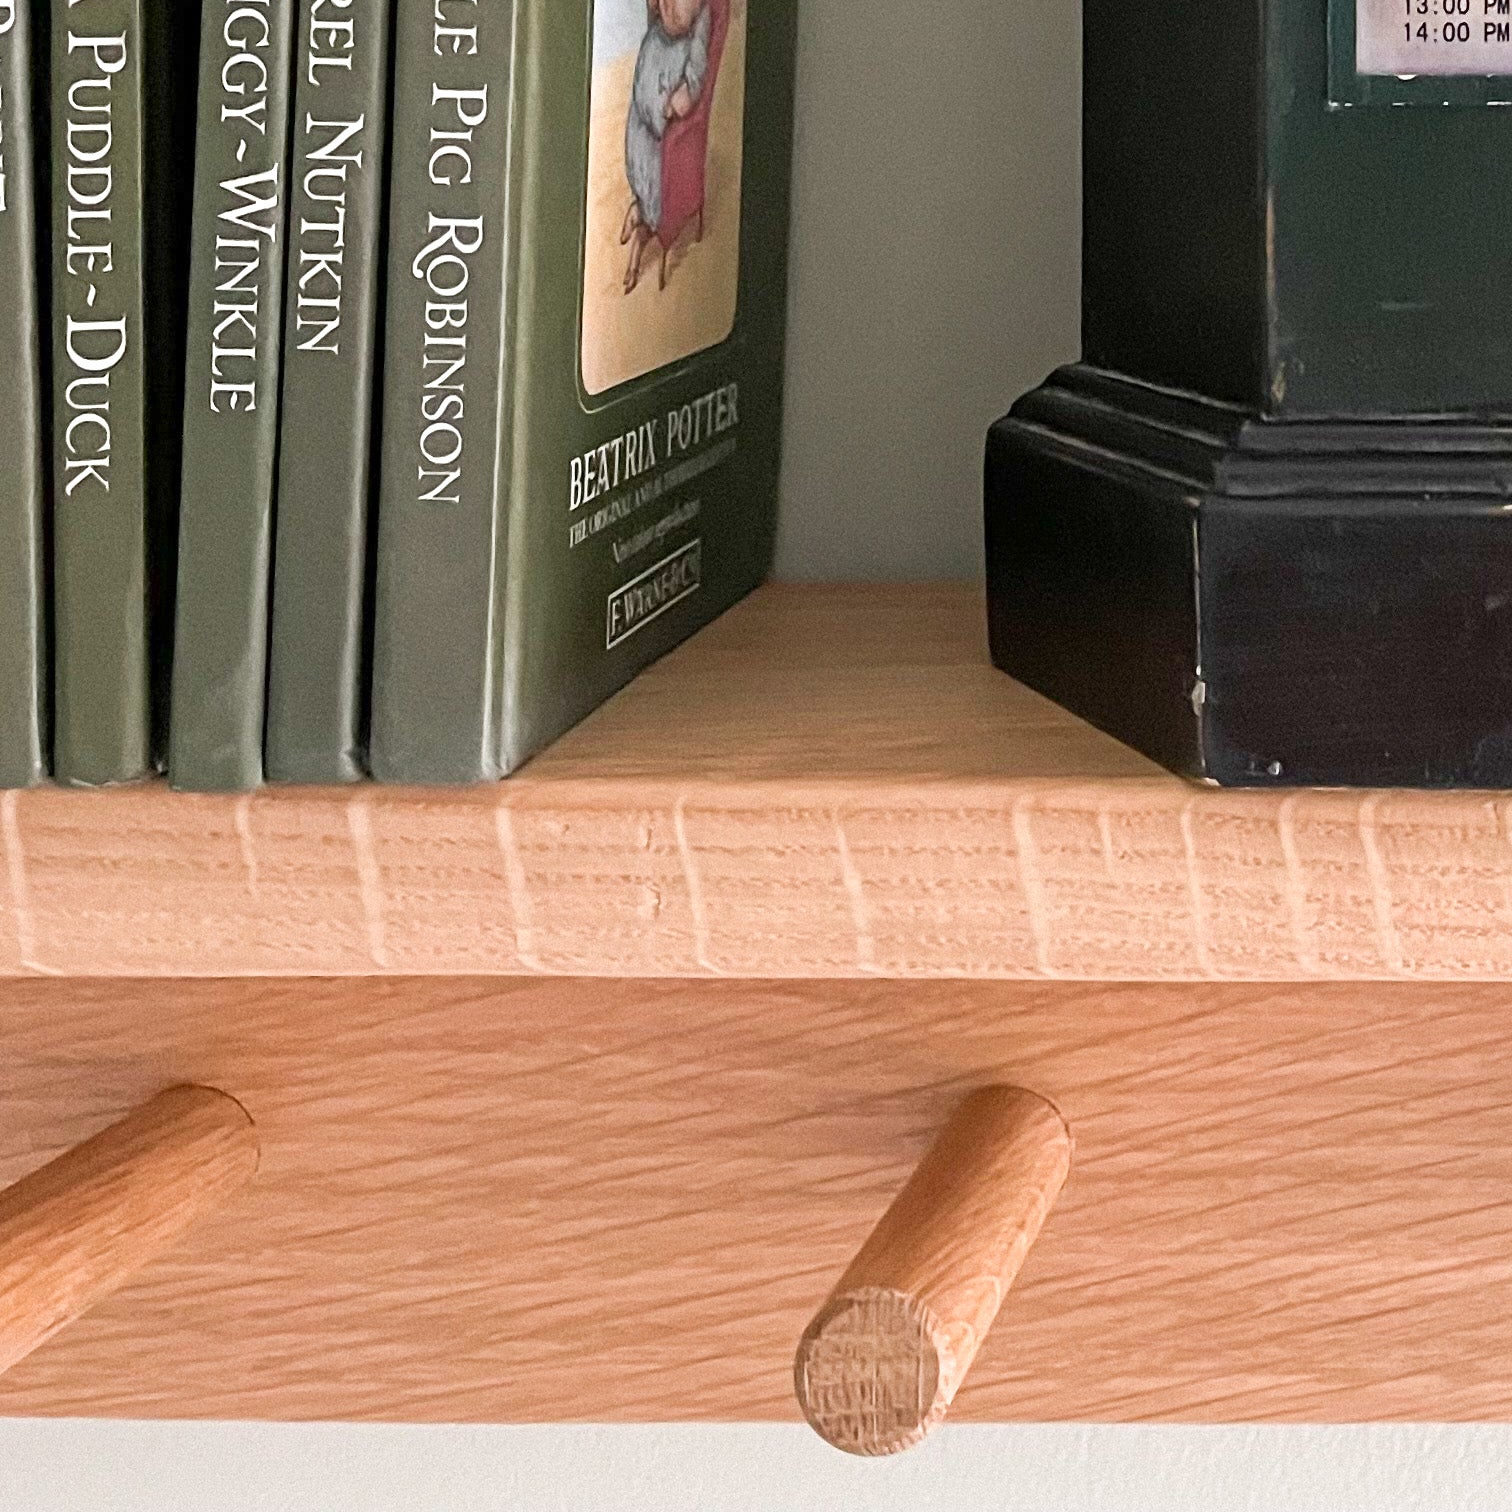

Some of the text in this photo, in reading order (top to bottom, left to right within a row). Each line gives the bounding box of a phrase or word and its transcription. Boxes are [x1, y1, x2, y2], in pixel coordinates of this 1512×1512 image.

[1404, 21, 1510, 42] 14:00 PM
[428, 82, 488, 186] PIG
[297, 112, 366, 355] NUTKIN
[412, 211, 483, 504] ROBINSON
[569, 418, 658, 512] BEATRIX
[667, 382, 739, 457] POTTER
